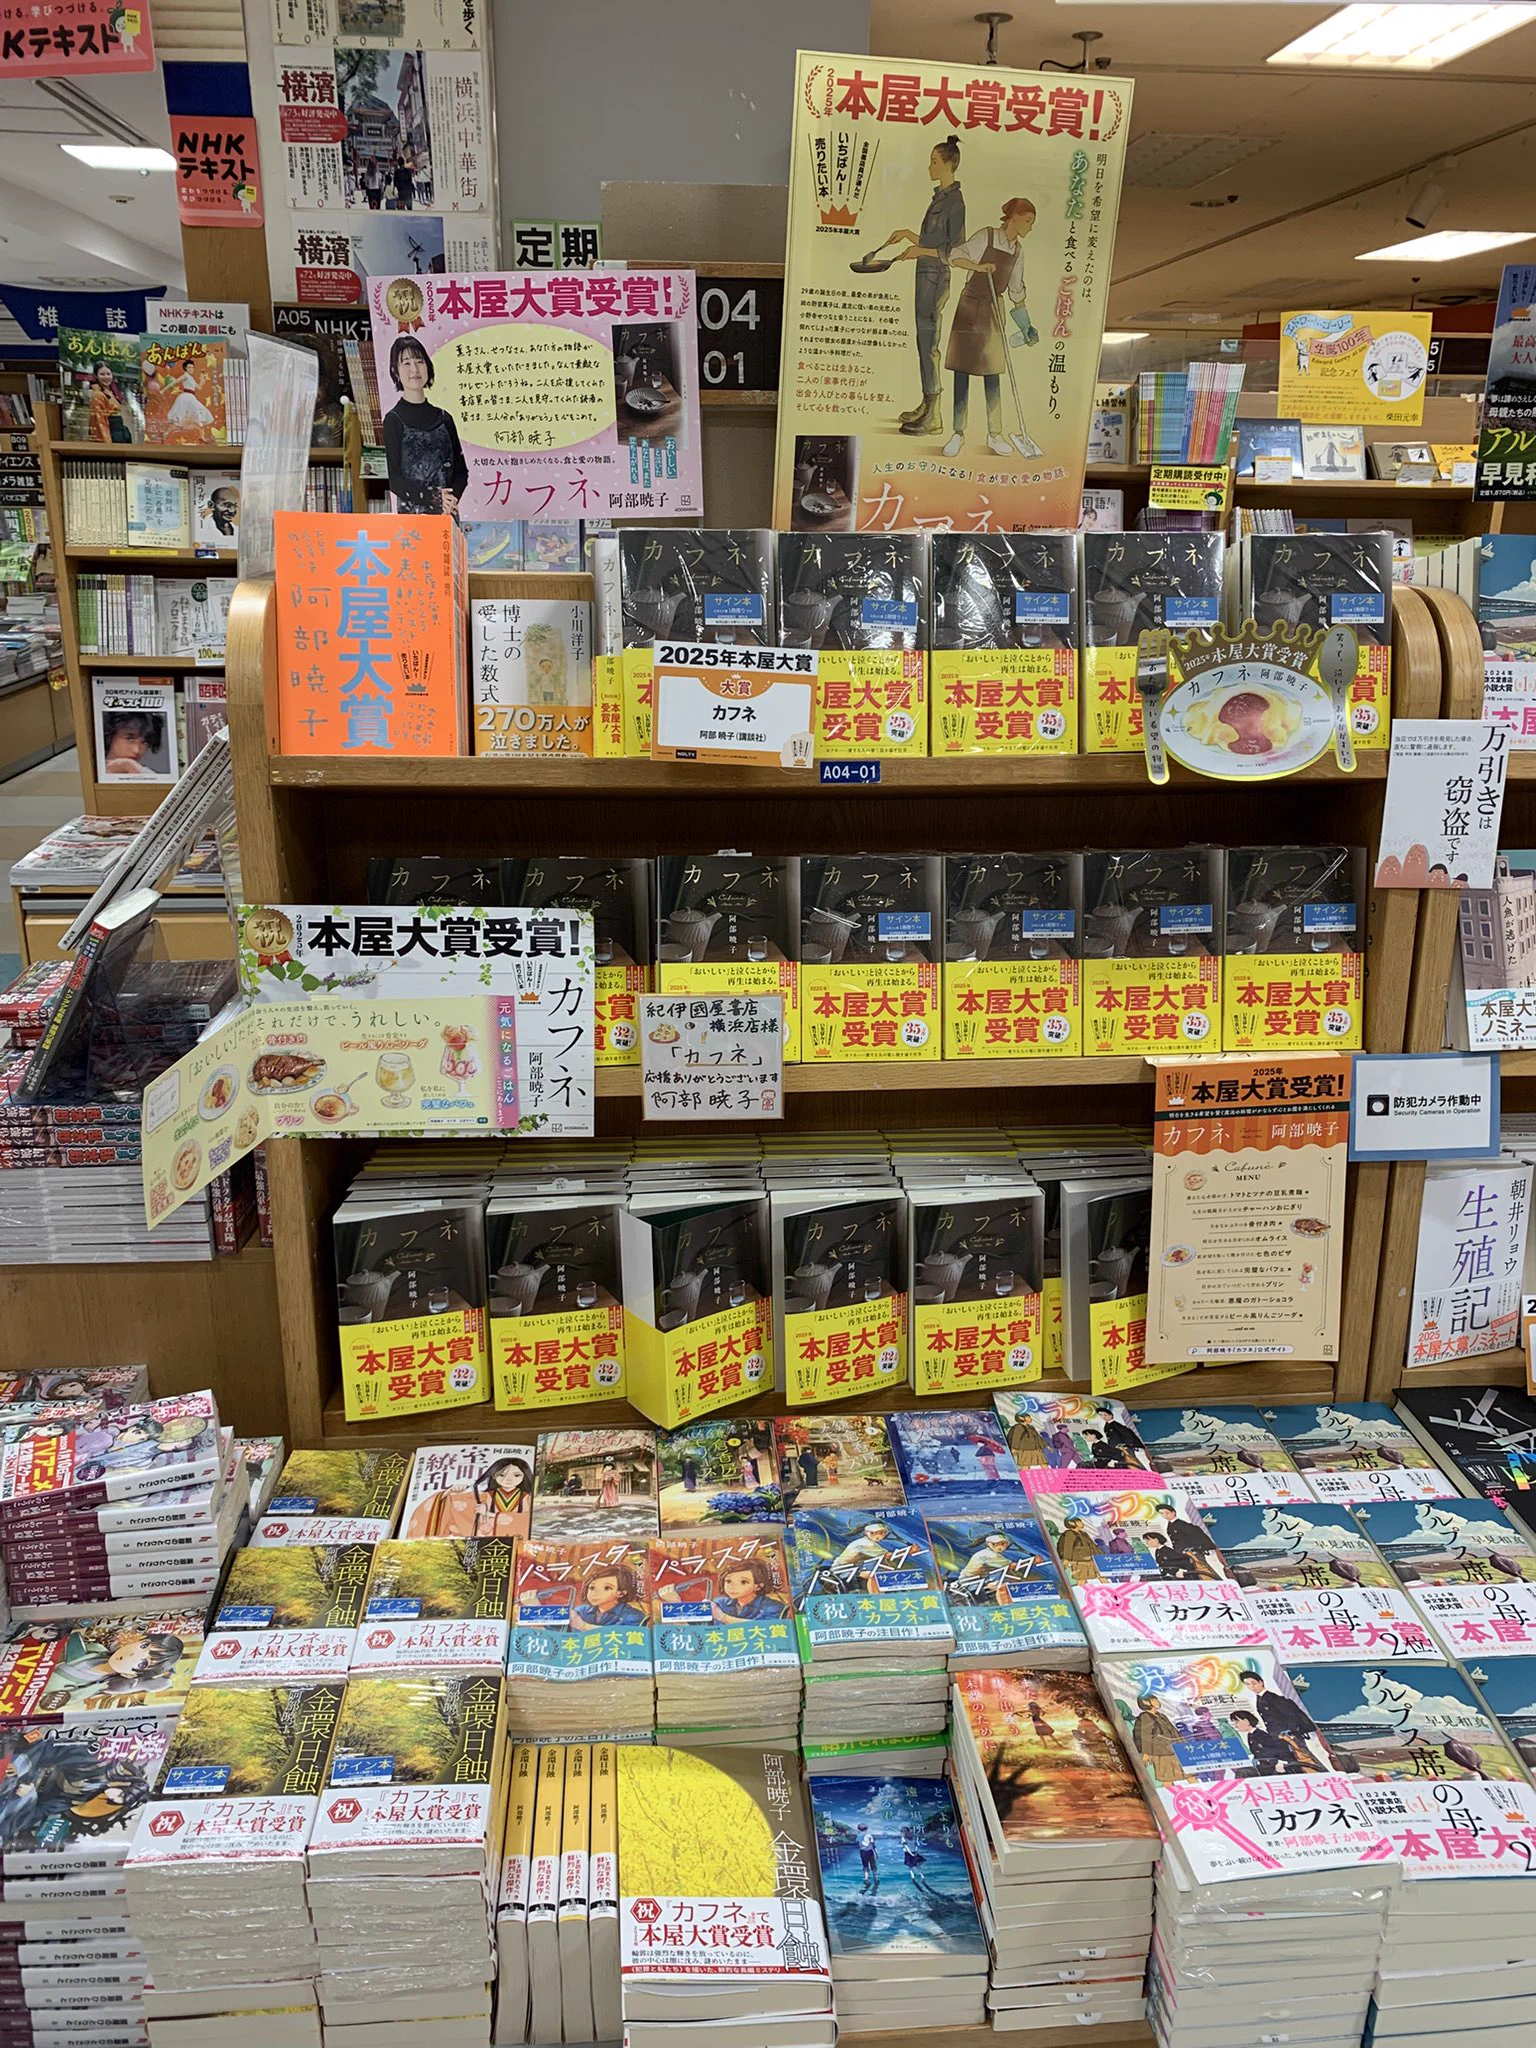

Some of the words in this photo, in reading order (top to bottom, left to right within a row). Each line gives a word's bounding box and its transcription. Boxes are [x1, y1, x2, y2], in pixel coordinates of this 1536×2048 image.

[279, 70, 336, 104] 横濱
[823, 68, 834, 117] 2025年
[836, 69, 1104, 141] 本屋大賞受賞!
[178, 132, 245, 155] NHK
[455, 76, 478, 198] 横浜中華街
[179, 157, 255, 180] テキスト
[815, 138, 829, 197] 売りたい本
[836, 132, 849, 194] いちばん!
[1081, 153, 1108, 304] 明日を希望に変えたのは、
[294, 235, 350, 266] 横濱
[516, 227, 599, 269] 定期
[1048, 150, 1090, 420] あなたと食べるごはんの温もり。
[391, 285, 420, 318] 祝
[426, 281, 437, 323] 2025年
[436, 277, 672, 320] 本屋大賞受賞!
[37, 305, 127, 329] 雑誌
[159, 308, 224, 320] NHKテキストは
[277, 309, 310, 325] A05
[160, 323, 236, 335] この棚の裏側にも
[67, 336, 136, 358] あんぱん
[147, 342, 208, 364] あんぱん
[1314, 330, 1366, 356] 生誕100年
[798, 361, 875, 374] 食べることは生きること。
[1320, 367, 1358, 377] 記念フェア
[797, 376, 867, 387] 二人の「家事代行」が
[796, 389, 895, 403] 出会う人びとの暮らしを整え、
[796, 403, 869, 415] そして心を救っていく。
[473, 455, 616, 467] 大切な人を抱きしめたくなる、食と愛の物語。
[1153, 469, 1227, 481] 定期購読受付中!
[484, 467, 601, 516] カフネ
[609, 492, 668, 509] 阿部暁子
[645, 540, 748, 568] カフネ
[335, 529, 395, 749] 本屋大賞
[502, 605, 522, 661] 博士の
[570, 605, 585, 661] 小川洋子
[478, 605, 500, 704] 愛した数式
[659, 645, 813, 673] 2025年本屋大賞
[961, 654, 1051, 664] 「おいしい」と泣くことから
[1000, 666, 1052, 675] 再生は始まる。
[720, 681, 752, 695] 大賞
[944, 678, 1064, 709] 本屋大賞
[477, 707, 590, 733] 270万人が
[713, 705, 757, 723] カフネ
[974, 711, 1034, 741] 受賞
[490, 732, 581, 750] 泣きました。
[699, 730, 717, 740] 阿部
[823, 764, 877, 780] A04-01
[1477, 724, 1511, 830] 万引きは
[1440, 775, 1474, 864] 窃盗です
[685, 864, 780, 890] カフネ
[824, 866, 918, 891] カフネ
[253, 919, 284, 947] 祝
[295, 915, 305, 957] 2025年
[307, 915, 580, 958] 本屋大賞受賞!
[729, 914, 738, 955] 阿部暁子
[1502, 895, 1518, 965] 人魚が逃げた
[689, 966, 777, 977] 「おいしい」と泣くことから
[727, 977, 778, 986] 再生は始まる。
[813, 991, 927, 1018] 本屋大賞
[957, 988, 1069, 1015] 本屋大賞
[1096, 984, 1208, 1012] 本屋大賞
[1237, 981, 1350, 1008] 本屋大賞
[646, 998, 759, 1019] 紀伊國屋書店
[709, 1017, 779, 1034] 横浜店様
[842, 1021, 899, 1047] 受賞
[985, 1018, 1040, 1044] 受賞
[1124, 1014, 1180, 1041] 受賞
[1264, 1010, 1322, 1037] 受賞
[498, 1001, 514, 1104] 元気になるごはん
[547, 977, 586, 1108] カフネ
[671, 1043, 763, 1066] 「カフネ」
[528, 1052, 545, 1108] 阿部暁子
[1253, 1067, 1284, 1077] 2025年
[1191, 1074, 1345, 1104] 本屋大賞受賞!
[1394, 1095, 1481, 1108] 防犯カメラ作動中
[1453, 1107, 1481, 1115] Operation
[1162, 1122, 1231, 1147] カフネ
[1271, 1121, 1340, 1139] 阿部暁子
[1503, 1179, 1526, 1277] 朝井リョウ
[1449, 1185, 1498, 1335] 生殖記
[799, 1321, 898, 1361] 本屋大賞
[927, 1320, 1032, 1352] 本屋大賞
[1413, 1326, 1515, 1359] 本屋大賞ノミネート
[1419, 1331, 1440, 1341] 2025
[357, 1336, 474, 1375] 本屋大賞
[504, 1332, 618, 1367] 本屋大賞
[954, 1350, 1006, 1378] 受賞
[388, 1369, 446, 1401] 受賞
[535, 1364, 591, 1393] 受賞
[472, 1538, 509, 1618] 金環日蝕
[878, 1572, 924, 1583] サイン本
[368, 1599, 419, 1611] サイン本
[522, 1606, 569, 1616] サイン本
[1149, 1603, 1252, 1623] 『カフネ』
[1260, 1608, 1295, 1616] 小説大賞
[526, 1637, 549, 1654] 祝
[814, 1626, 920, 1641] 阿部暁子の注目作!
[511, 1661, 619, 1678] 阿部暁子の注目作!
[659, 1654, 767, 1672] 阿部暁子の注目作!
[452, 1678, 498, 1783] 金環日蝕
[1425, 1715, 1489, 1728] 早見和真
[282, 1687, 340, 1795] 金環日蝕
[1184, 1741, 1230, 1752] サイン本
[171, 1768, 227, 1780] サイン本
[336, 1759, 392, 1772] サイン本
[764, 1753, 791, 1821] 阿部暁子
[1250, 1803, 1373, 1835] 『カフネ』
[1283, 1833, 1381, 1848] 阿部暁子が贈る
[636, 1901, 654, 1919] 祝
[769, 1830, 826, 1973] 金環日蝕
[641, 1925, 776, 1949] 本屋大賞受賞
